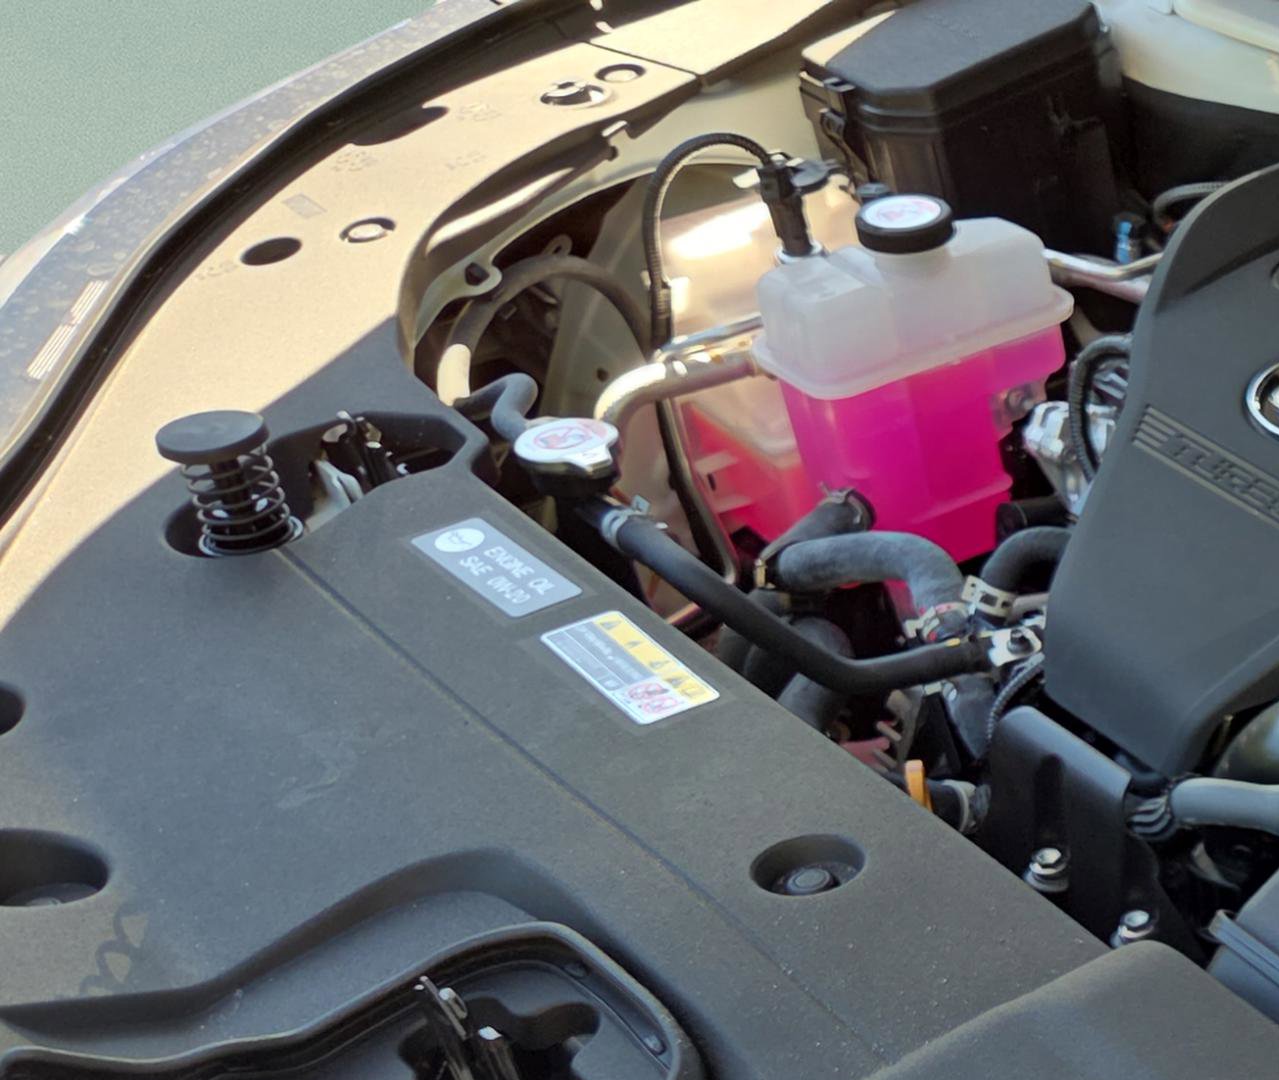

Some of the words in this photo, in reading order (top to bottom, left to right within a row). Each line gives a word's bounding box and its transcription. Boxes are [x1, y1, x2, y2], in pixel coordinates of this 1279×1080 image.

[460, 556, 493, 576] SAE
[484, 546, 535, 578] ENGINE
[529, 578, 555, 595] OIL
